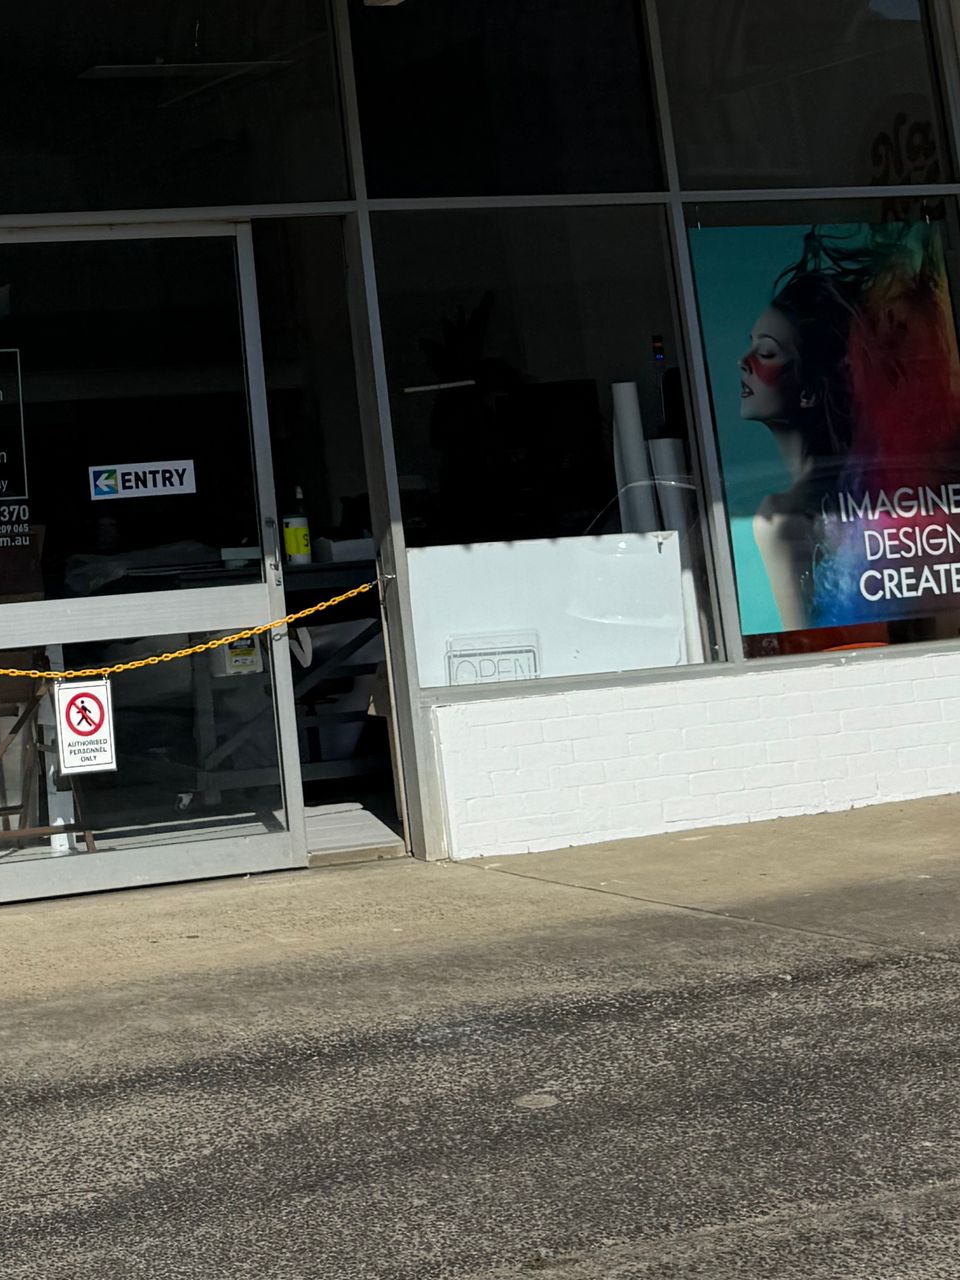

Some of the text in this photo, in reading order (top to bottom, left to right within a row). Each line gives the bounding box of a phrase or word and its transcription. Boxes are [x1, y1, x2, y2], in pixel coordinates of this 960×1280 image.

[121, 468, 187, 490] ENTRY
[838, 483, 960, 523] IMAGINE
[859, 562, 960, 601] CREATE
[67, 738, 107, 748] AUTHORISED
[69, 746, 107, 756] PERSONNEL
